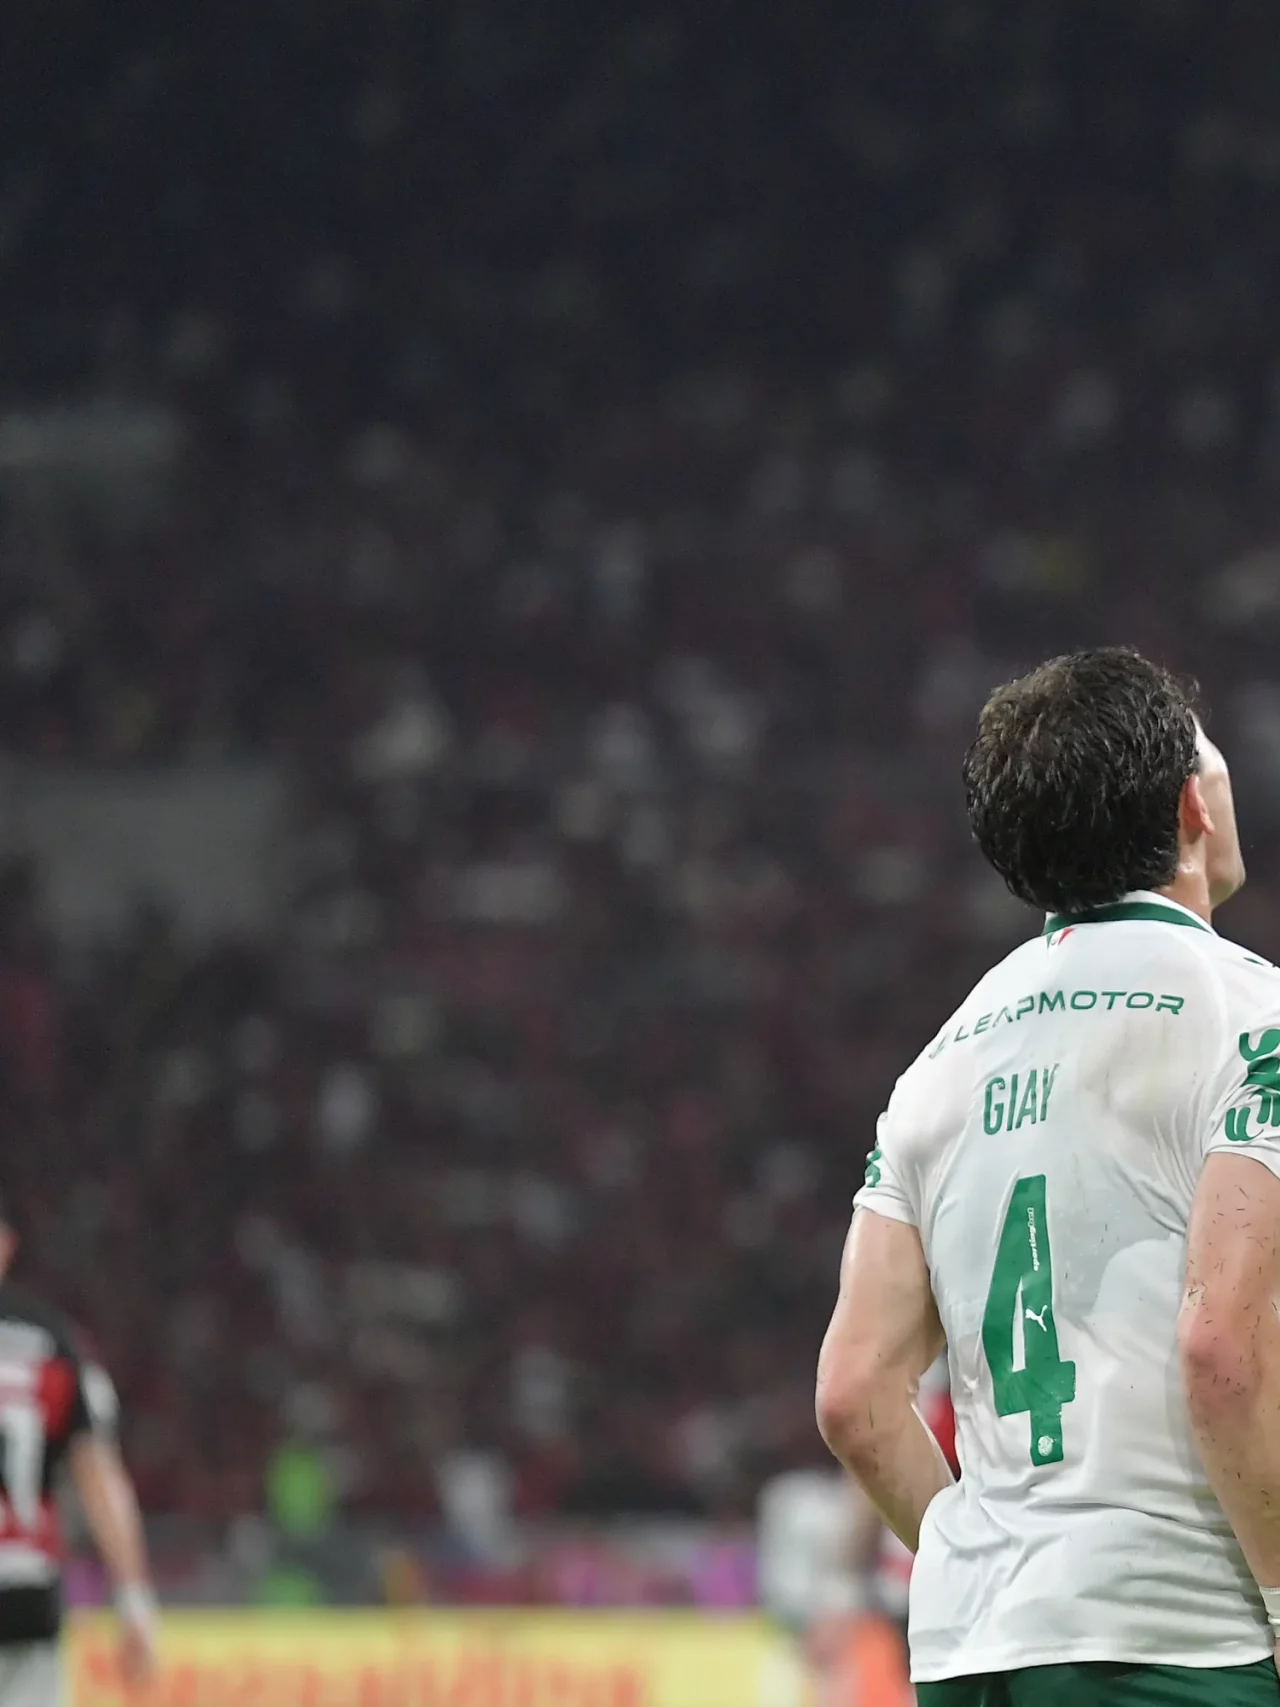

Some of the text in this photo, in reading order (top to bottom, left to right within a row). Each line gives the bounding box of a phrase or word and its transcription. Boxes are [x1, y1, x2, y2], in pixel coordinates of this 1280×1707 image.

[953, 990, 1185, 1043] LEAPMOTOR
[983, 1063, 1060, 1135] GIAY
[982, 1174, 1076, 1467] 4
